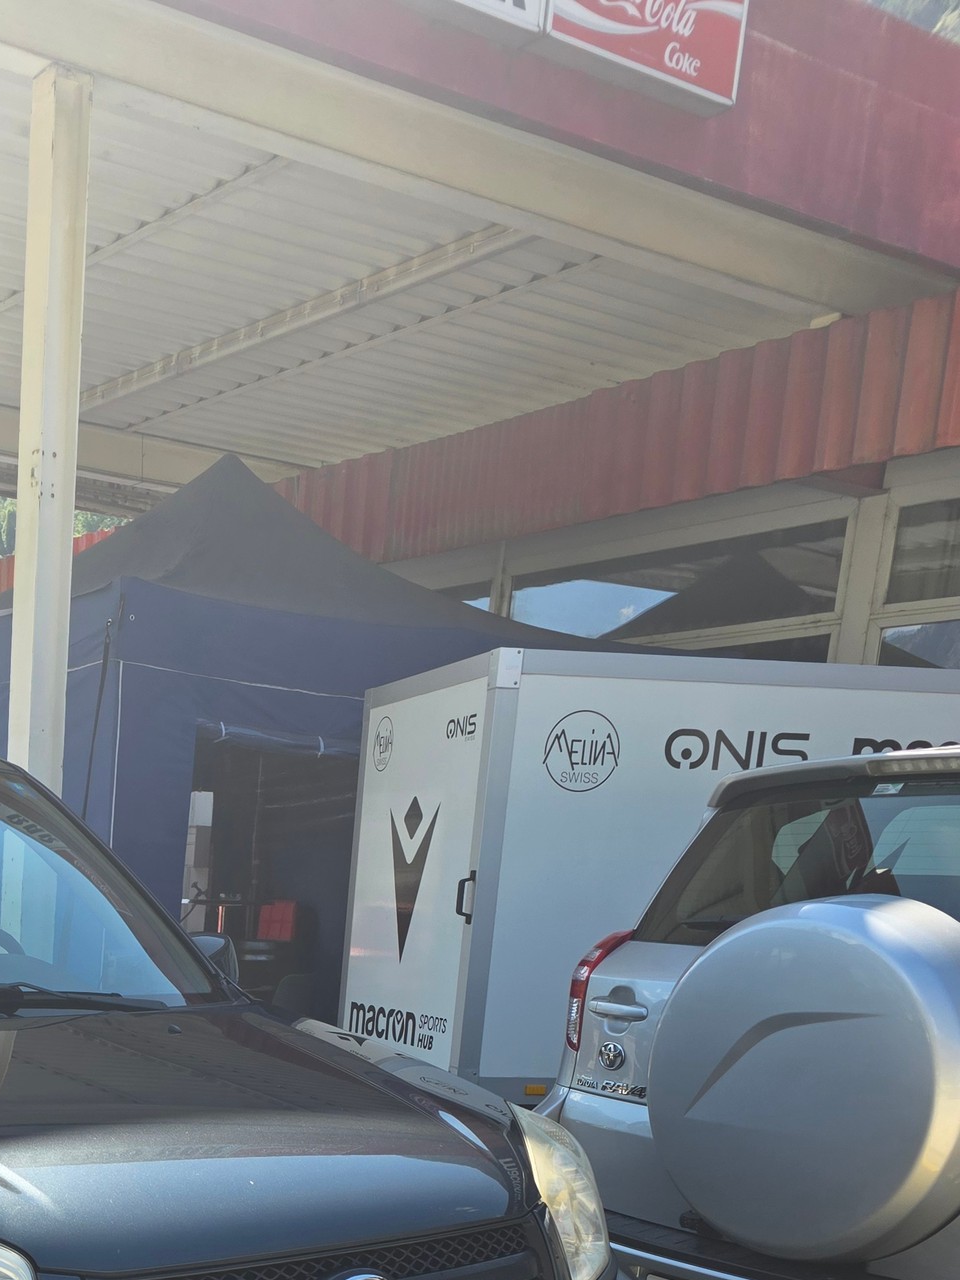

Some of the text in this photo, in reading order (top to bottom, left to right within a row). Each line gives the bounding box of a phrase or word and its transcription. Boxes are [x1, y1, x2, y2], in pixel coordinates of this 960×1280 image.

[664, 41, 701, 77] Coke
[560, 771, 600, 785] SWISS
[348, 1001, 448, 1047] macron SPORTS
[416, 1032, 434, 1051] HUB
[601, 1080, 648, 1099] RAV4
